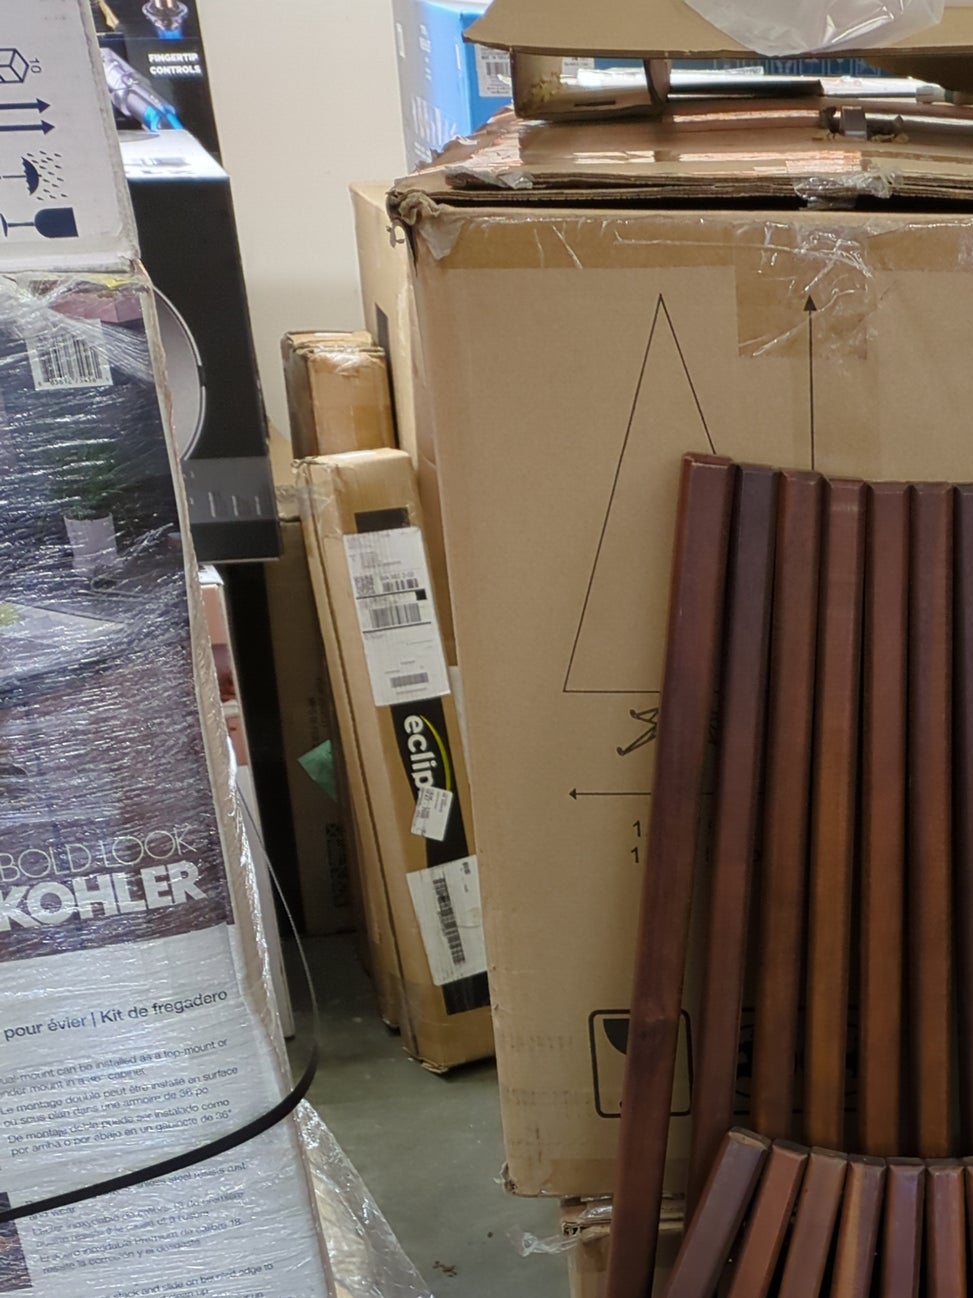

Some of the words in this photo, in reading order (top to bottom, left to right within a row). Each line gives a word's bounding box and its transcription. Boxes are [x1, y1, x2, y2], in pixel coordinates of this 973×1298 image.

[29, 57, 42, 74] 10
[148, 53, 199, 63] FINGERTIP
[150, 65, 202, 75] CONTROLS
[102, 826, 198, 868] LOOK
[0, 860, 207, 932] KOHLER
[4, 1021, 43, 1042] pour
[47, 1015, 88, 1032] évier
[101, 1008, 124, 1024] Kit
[128, 1004, 148, 1019] de
[152, 989, 228, 1014] fregadero
